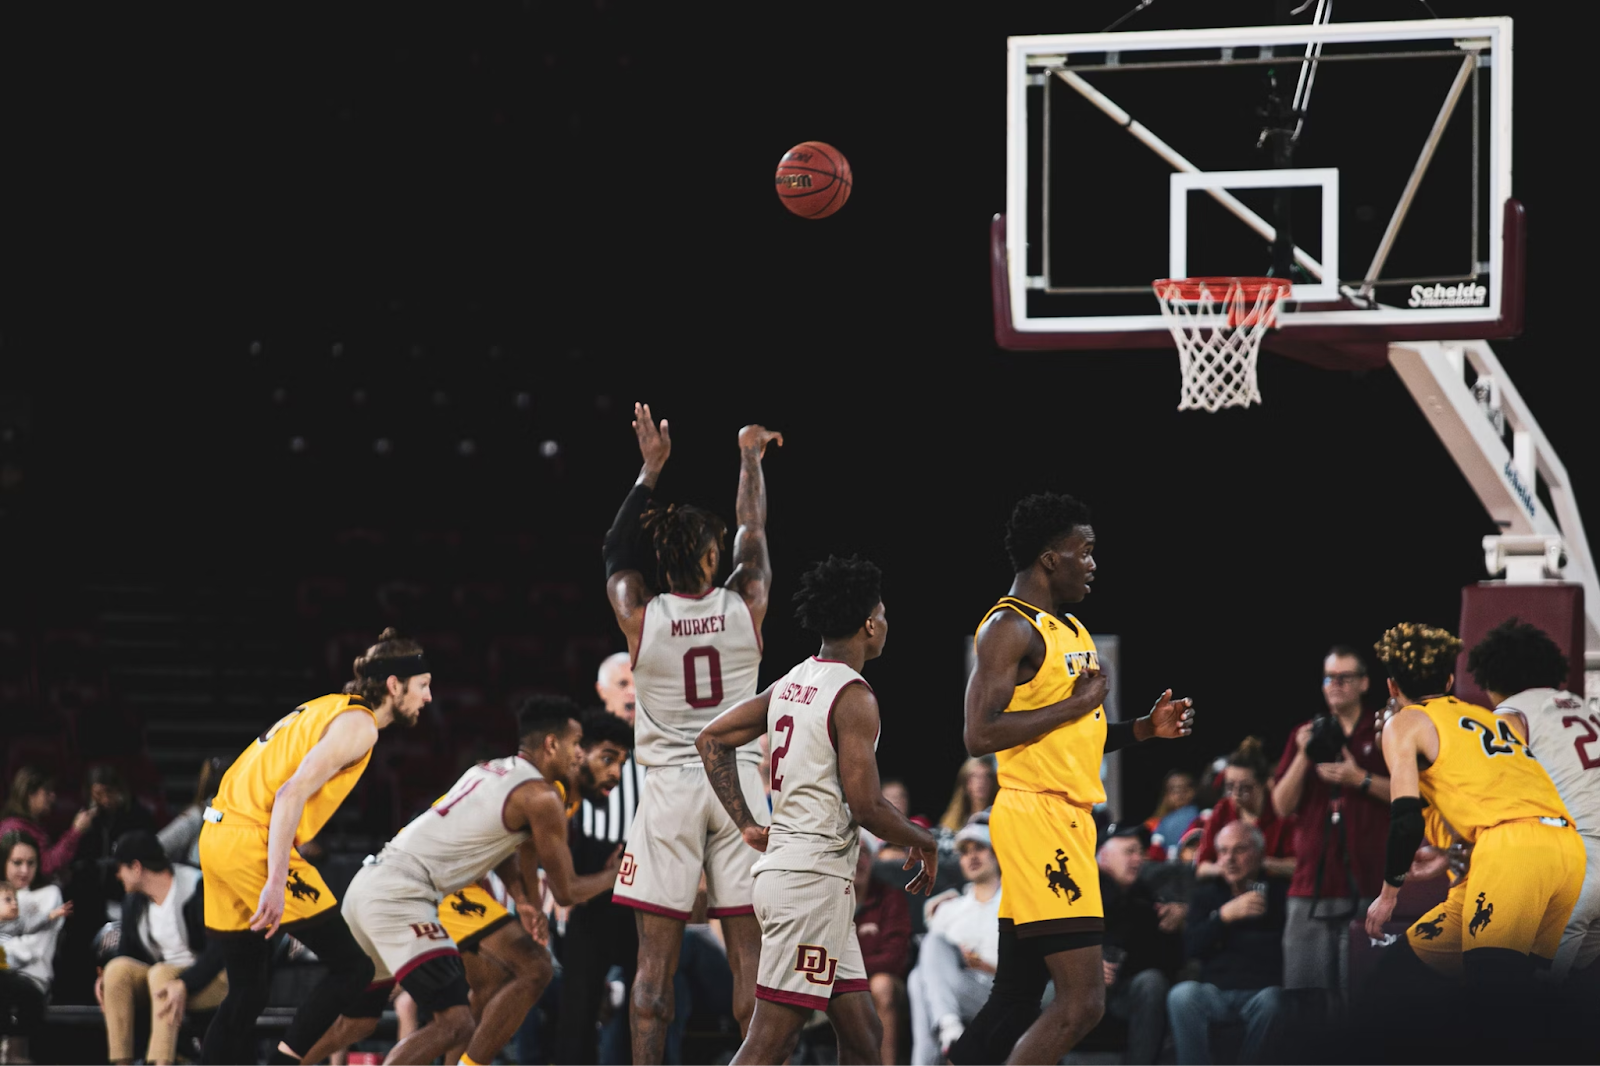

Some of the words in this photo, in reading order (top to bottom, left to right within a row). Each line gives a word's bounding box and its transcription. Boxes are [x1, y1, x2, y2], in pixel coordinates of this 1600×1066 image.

[671, 614, 726, 637] MURKEY
[683, 645, 724, 710] 0
[771, 714, 795, 793] 2
[1562, 714, 1600, 771] 2
[794, 944, 838, 986] DU
